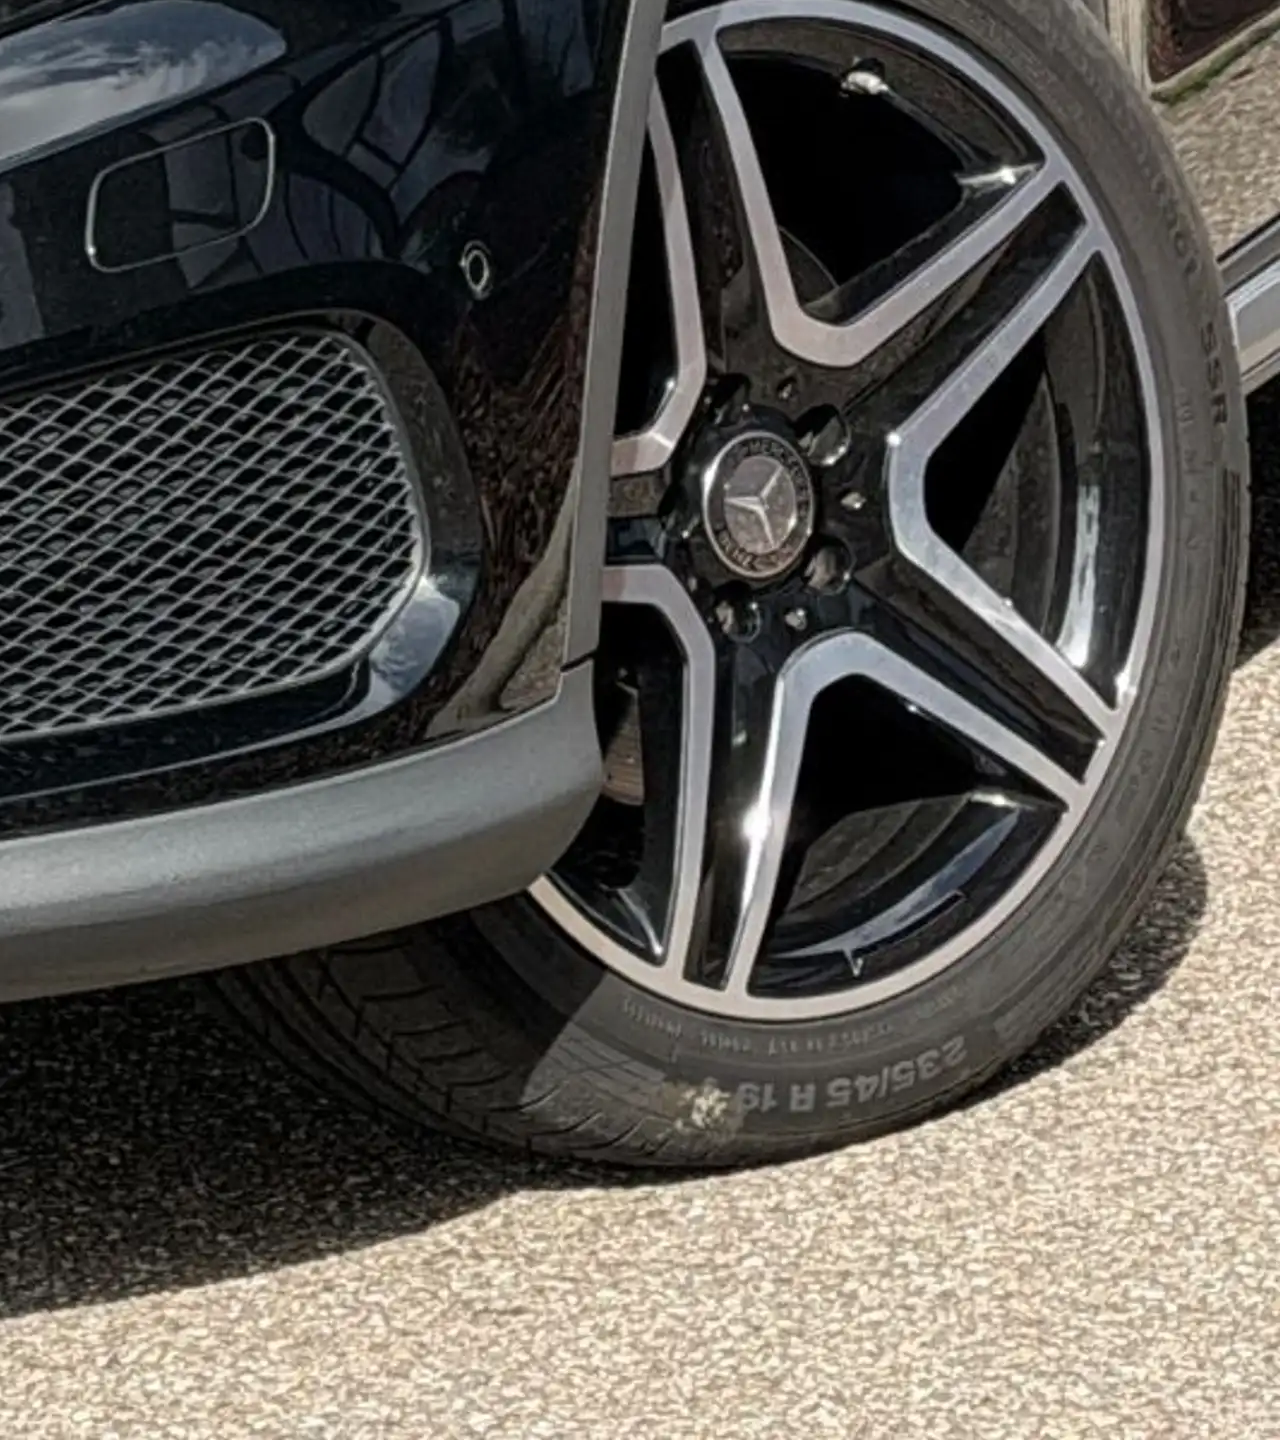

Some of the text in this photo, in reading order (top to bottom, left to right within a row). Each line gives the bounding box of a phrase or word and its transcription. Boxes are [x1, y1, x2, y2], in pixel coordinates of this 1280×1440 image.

[739, 1034, 969, 1113] 235/45 R 19
